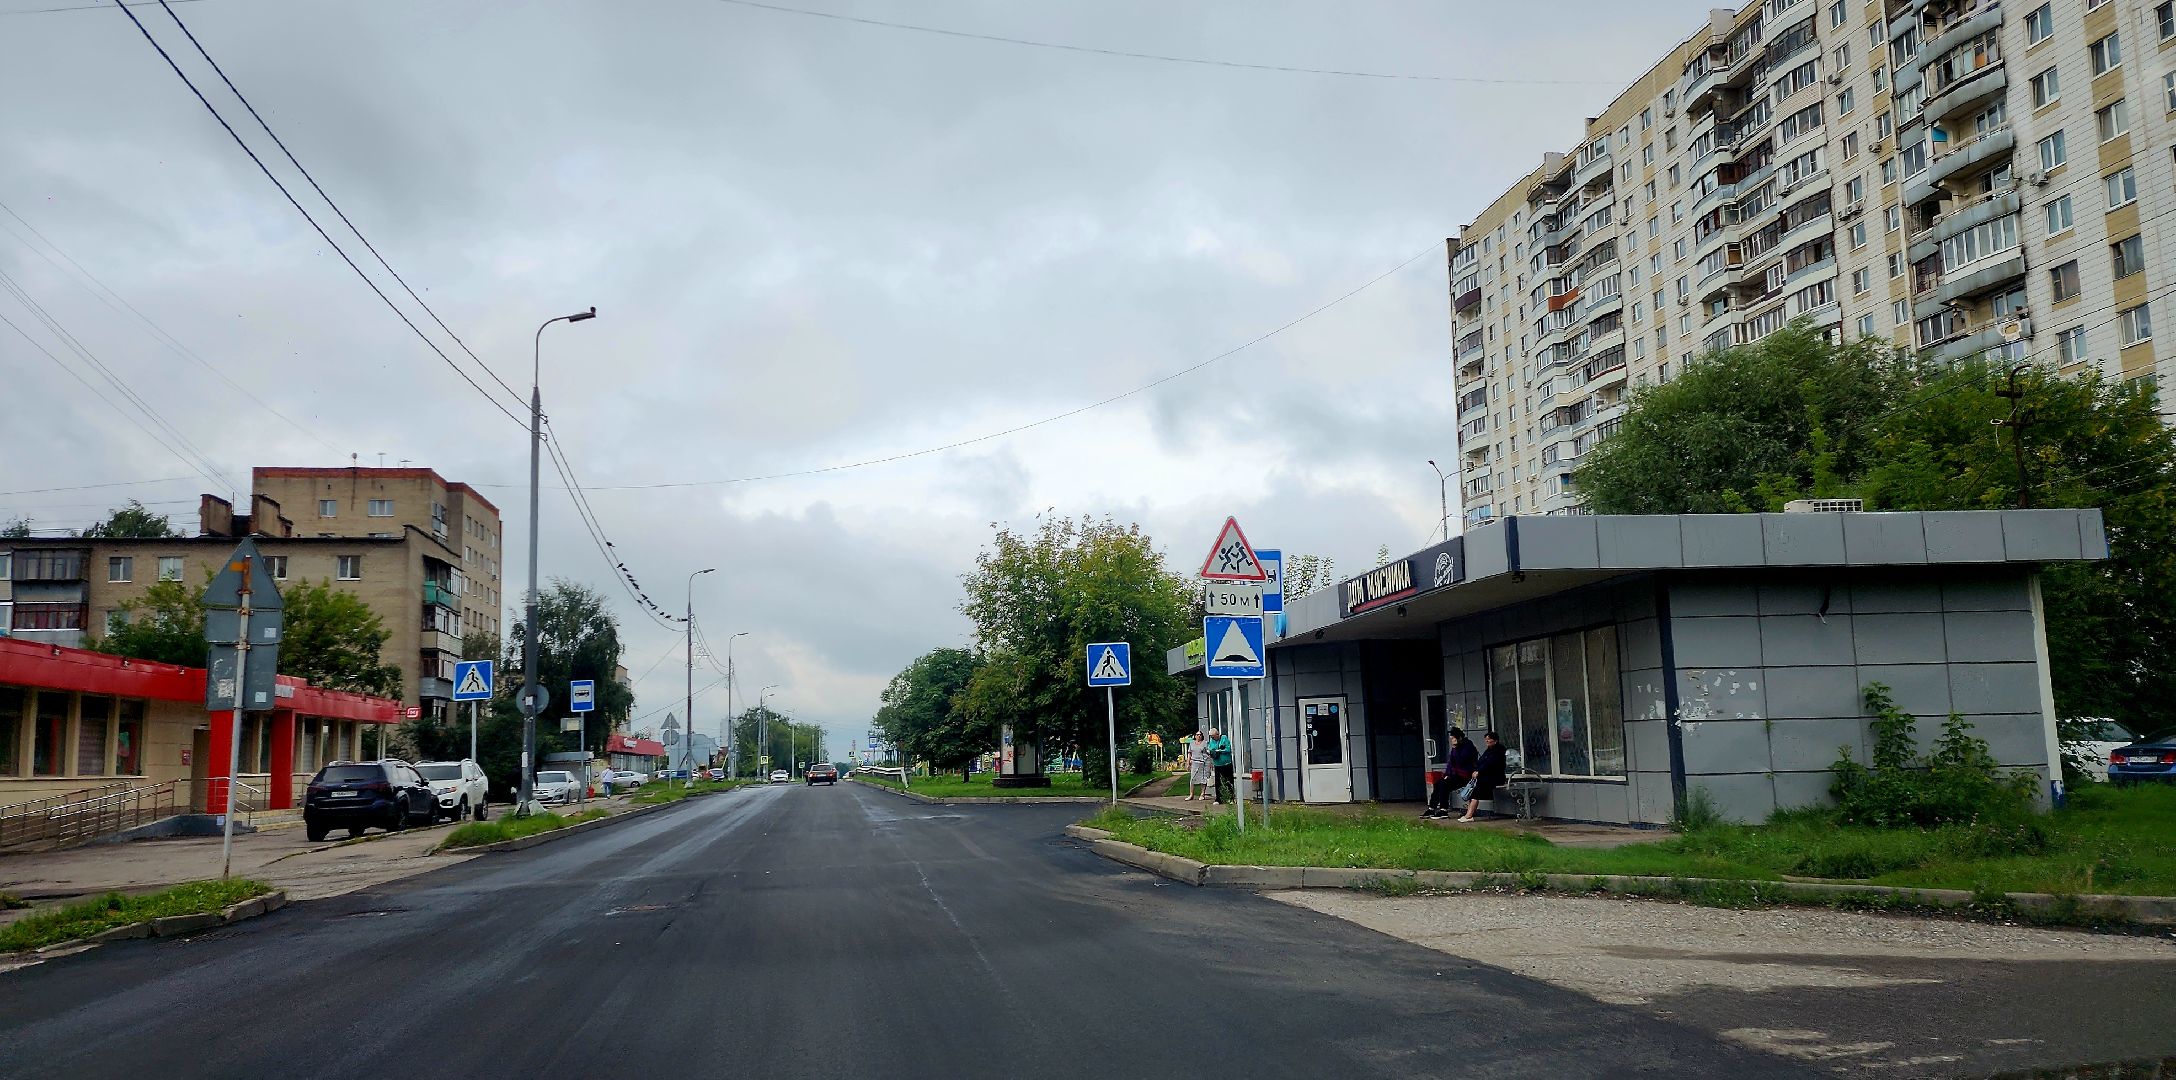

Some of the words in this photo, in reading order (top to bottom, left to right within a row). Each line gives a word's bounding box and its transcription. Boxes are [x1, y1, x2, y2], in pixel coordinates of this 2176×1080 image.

[1221, 593, 1237, 606] 50
[1347, 577, 1364, 613] ДОМ
[1366, 559, 1411, 601] МЯСНИКА
